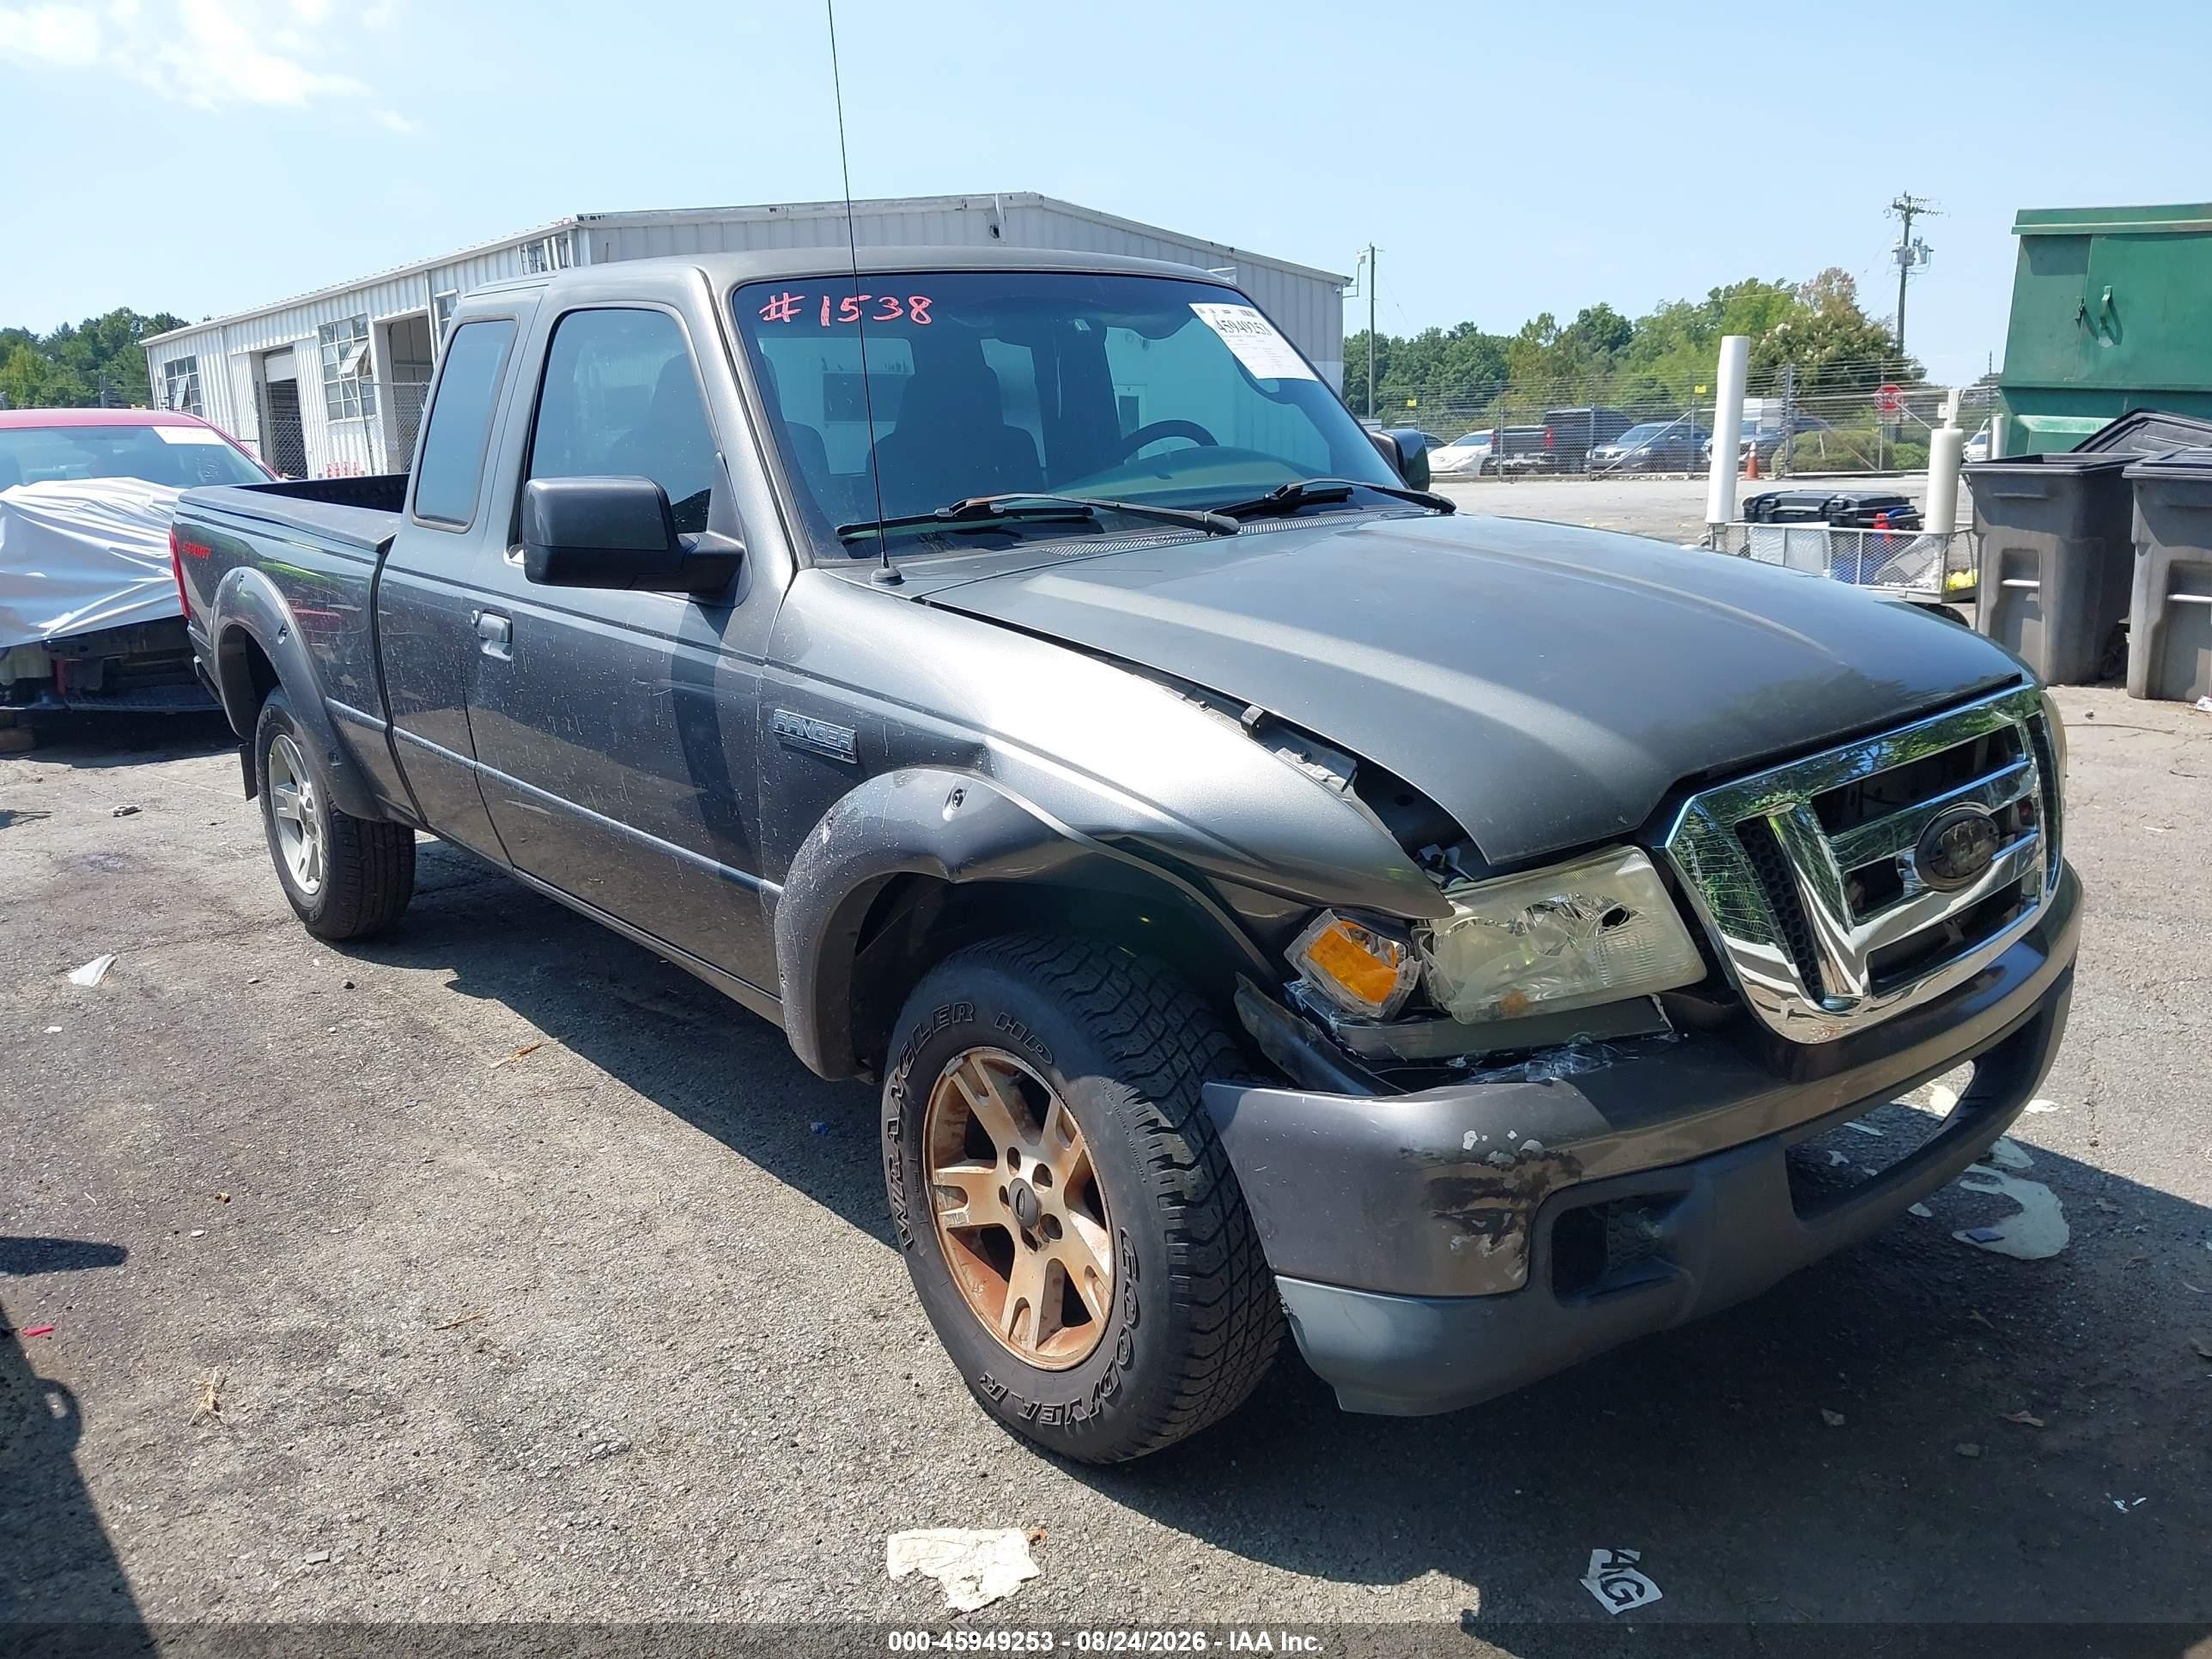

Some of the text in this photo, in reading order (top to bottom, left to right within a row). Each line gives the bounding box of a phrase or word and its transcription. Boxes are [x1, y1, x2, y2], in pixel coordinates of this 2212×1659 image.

[759, 292, 933, 328] # 1538
[1215, 319, 1273, 337] 45949253
[773, 712, 853, 751] RANGER
[886, 1002, 975, 1250] WRANGLER
[994, 1011, 1053, 1065] HP
[978, 1226, 1141, 1427] GOODYEAR
